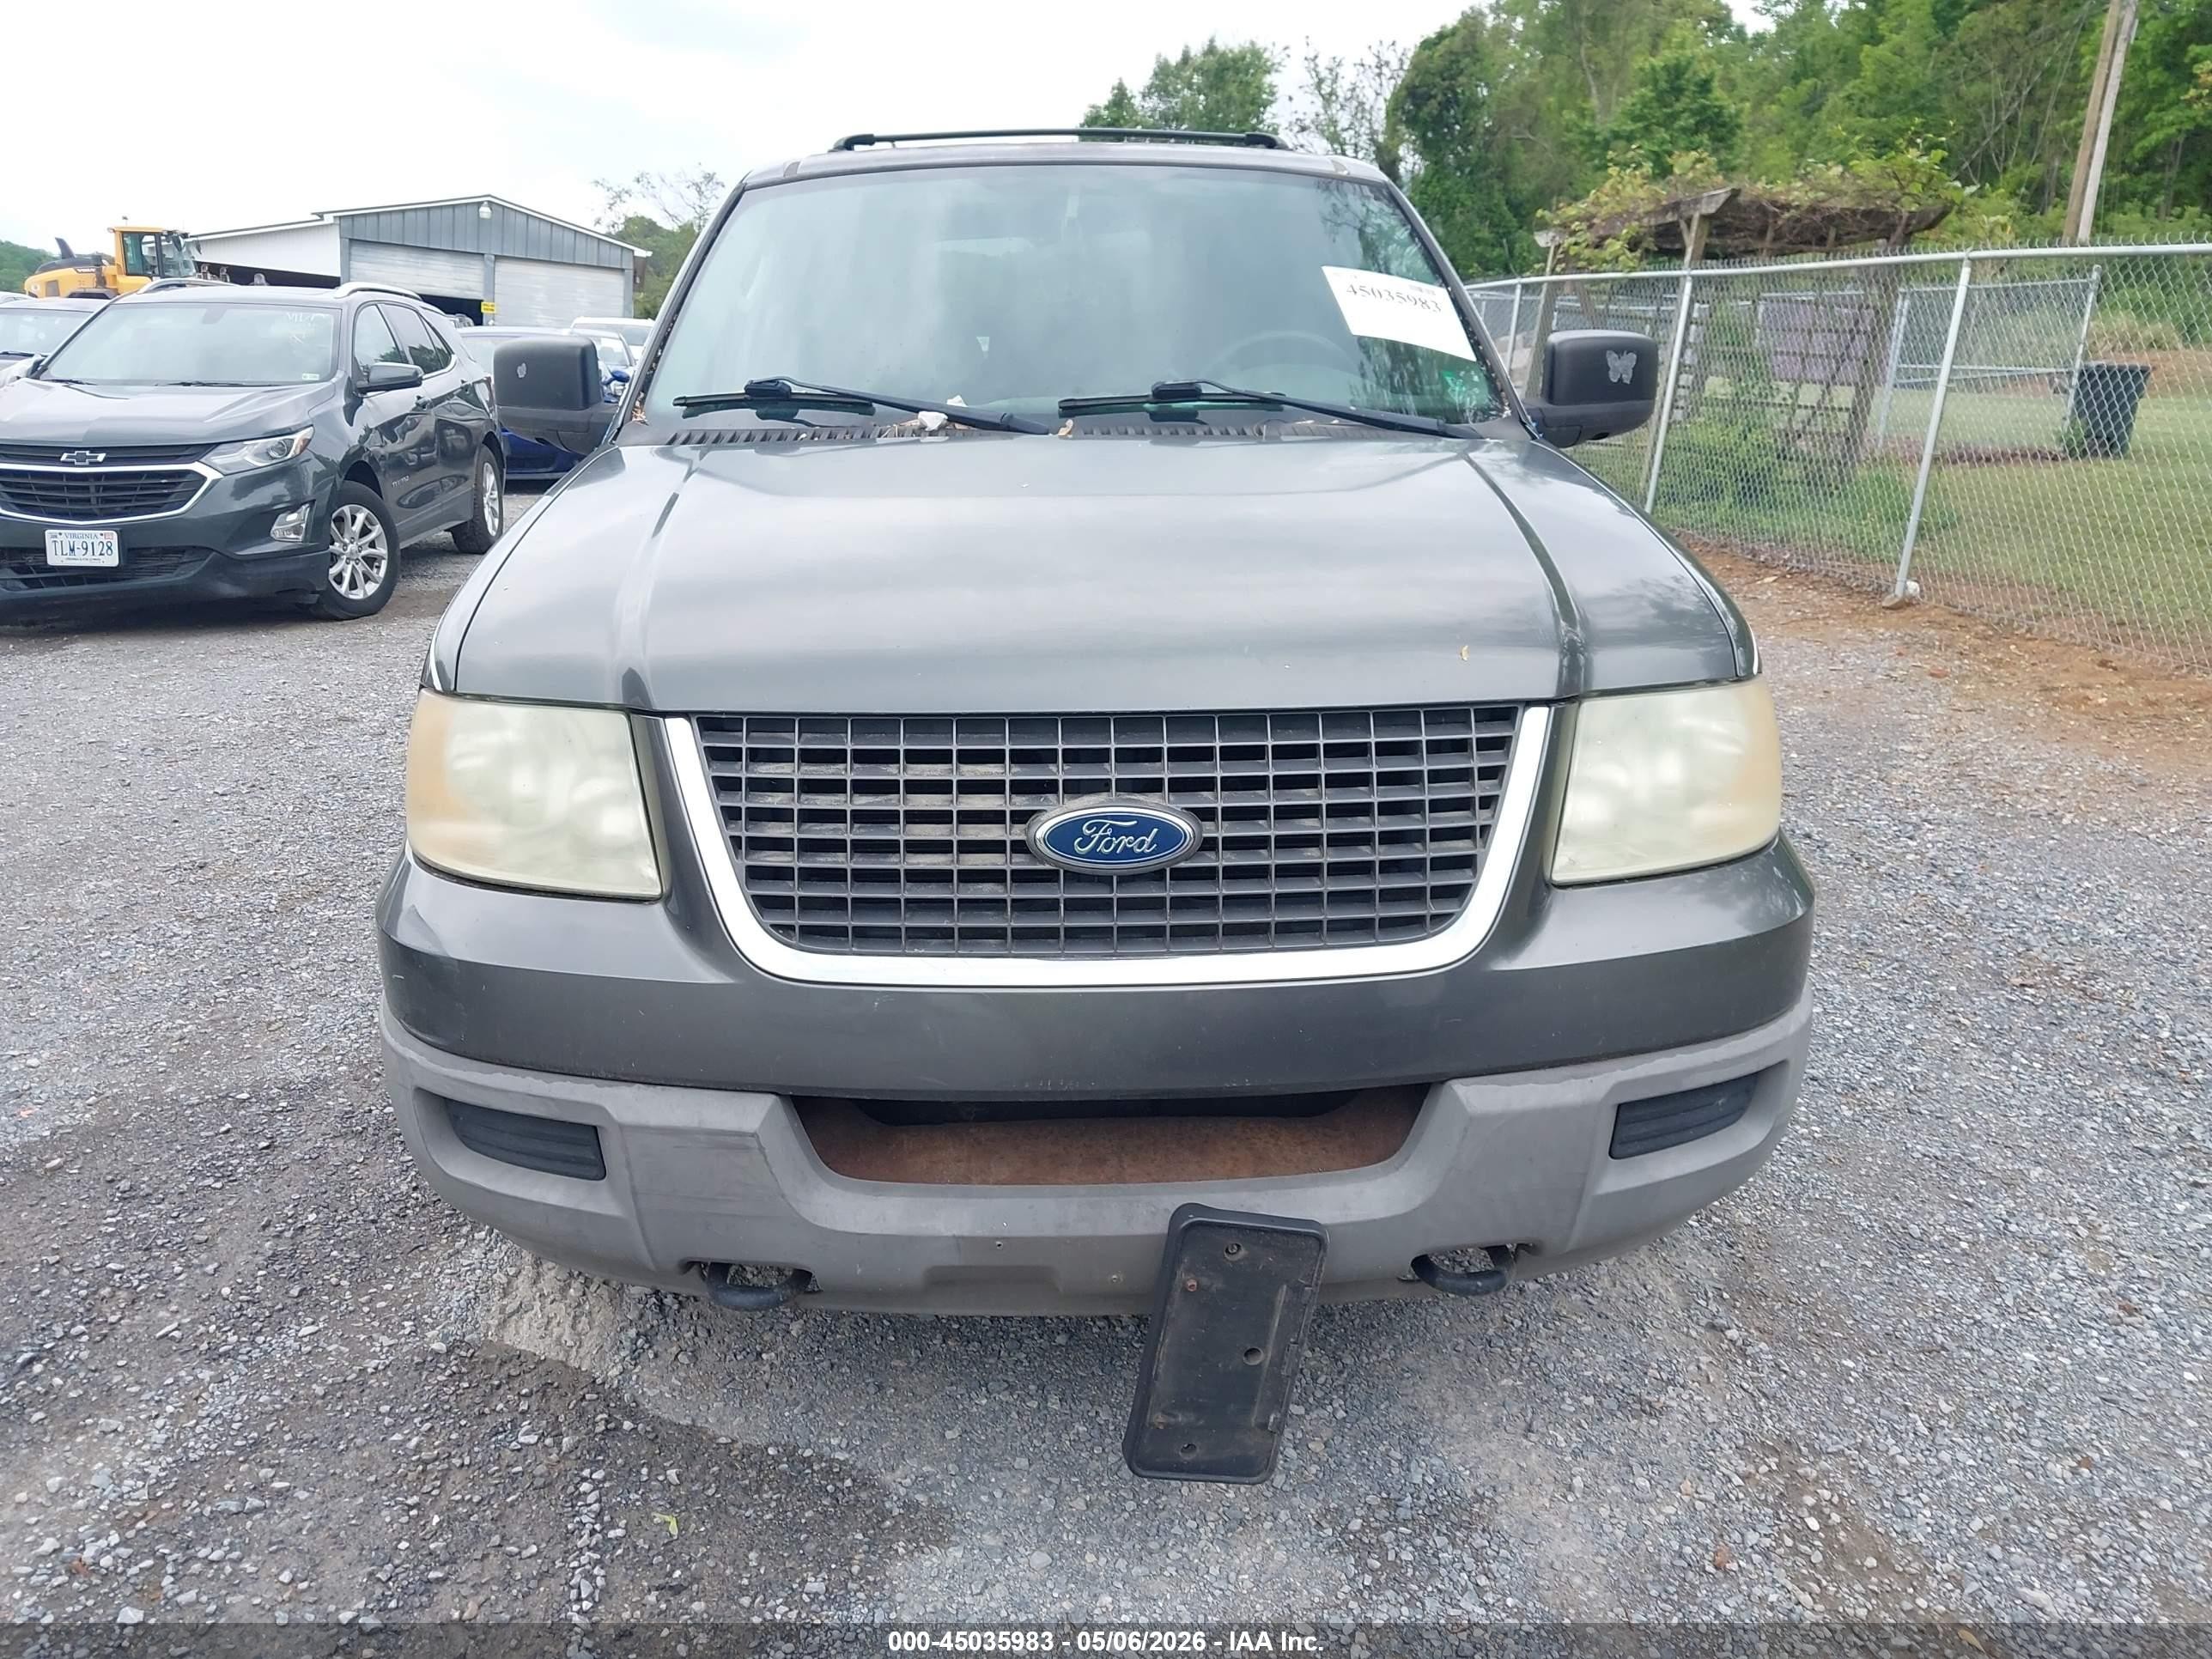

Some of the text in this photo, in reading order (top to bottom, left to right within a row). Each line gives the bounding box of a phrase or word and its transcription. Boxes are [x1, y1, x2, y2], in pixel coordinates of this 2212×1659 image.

[1346, 284, 1442, 313] 45035983
[52, 540, 113, 556] TLM-9128
[1074, 818, 1159, 854] Ford
